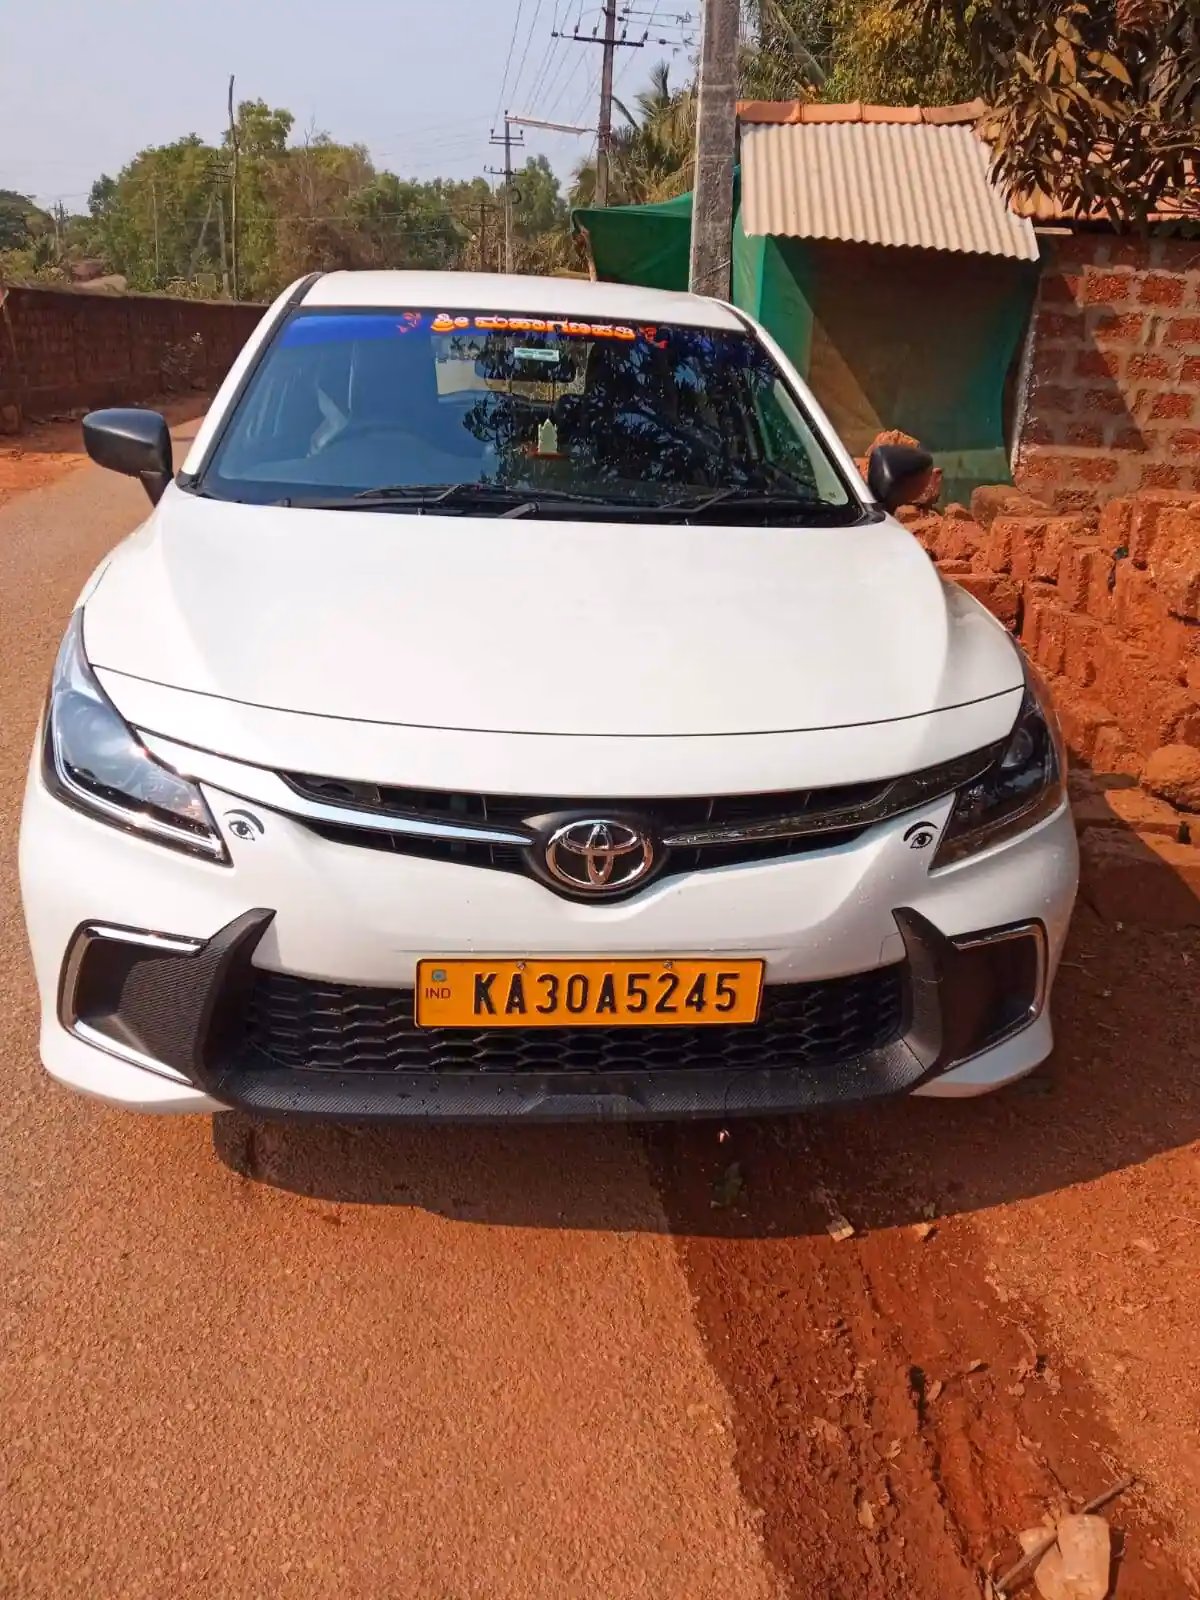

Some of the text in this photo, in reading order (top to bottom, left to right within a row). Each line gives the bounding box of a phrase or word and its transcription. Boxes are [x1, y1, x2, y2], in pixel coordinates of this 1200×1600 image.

[431, 313, 470, 332] ಶ್ರೀ
[425, 987, 452, 999] IND
[473, 972, 741, 1015] KA30A5245
